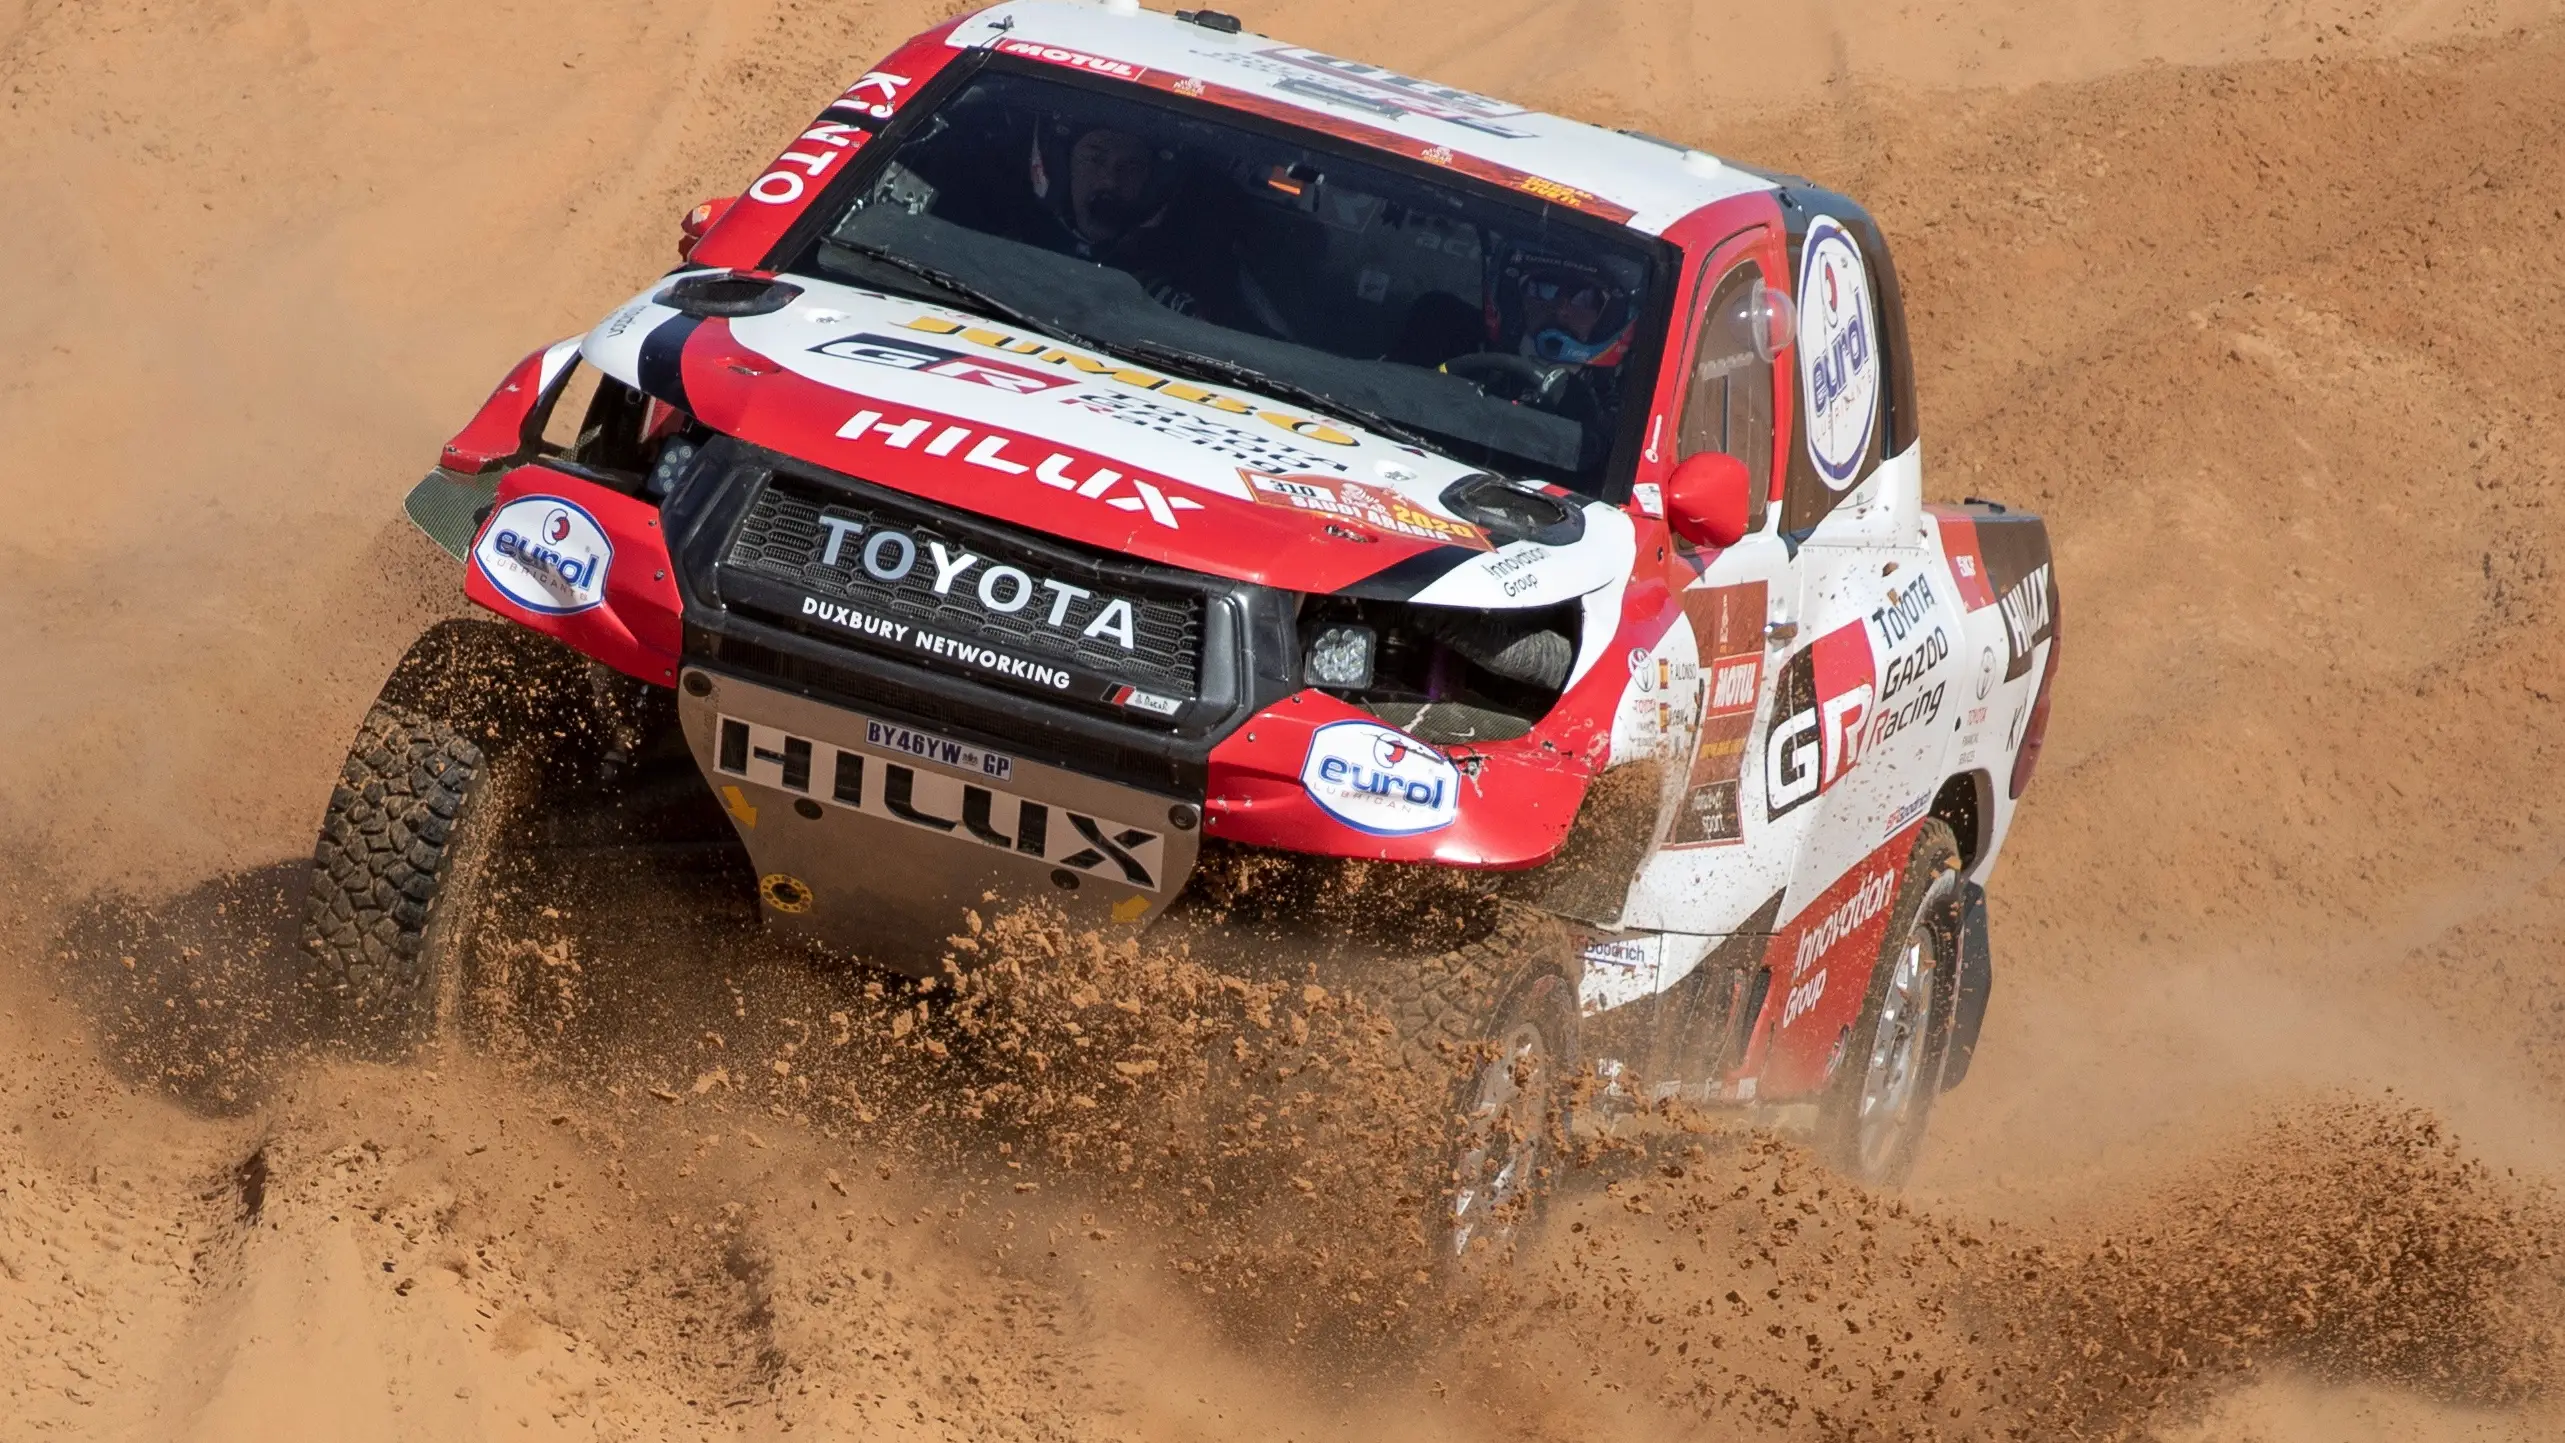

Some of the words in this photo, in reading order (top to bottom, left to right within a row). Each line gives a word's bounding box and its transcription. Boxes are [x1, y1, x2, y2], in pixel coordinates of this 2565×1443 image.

[1006, 43, 1132, 76] MOTUL
[812, 333, 1075, 394] GR
[888, 316, 1360, 447] JUMBO
[1813, 287, 1869, 418] eurol
[835, 410, 1204, 530] HILUX
[1269, 479, 1318, 497] 310
[1290, 494, 1362, 518] SAUDI
[1366, 510, 1453, 541] ARABIA
[1392, 503, 1475, 538] 2020
[485, 555, 589, 600] LUBRICANTS
[493, 529, 600, 591] eurol
[819, 515, 1135, 649] TOYOTA
[1481, 547, 1550, 580] Innovation
[1503, 573, 1538, 598] Group
[1872, 572, 1936, 649] TOYOTA
[802, 597, 909, 643] DUXBURY
[915, 631, 1071, 689] NETWORKING
[1882, 625, 1948, 702] GAZOO
[1713, 661, 1757, 710] MOTUL
[1866, 680, 1946, 753] Racing
[867, 719, 963, 767] BY46YW
[982, 753, 1012, 781] GP
[1767, 672, 1875, 815] GR
[720, 717, 1157, 889] HILUX
[1318, 754, 1446, 811] eurol
[1793, 868, 1895, 980] Innovation
[1783, 967, 1827, 1029] Group
